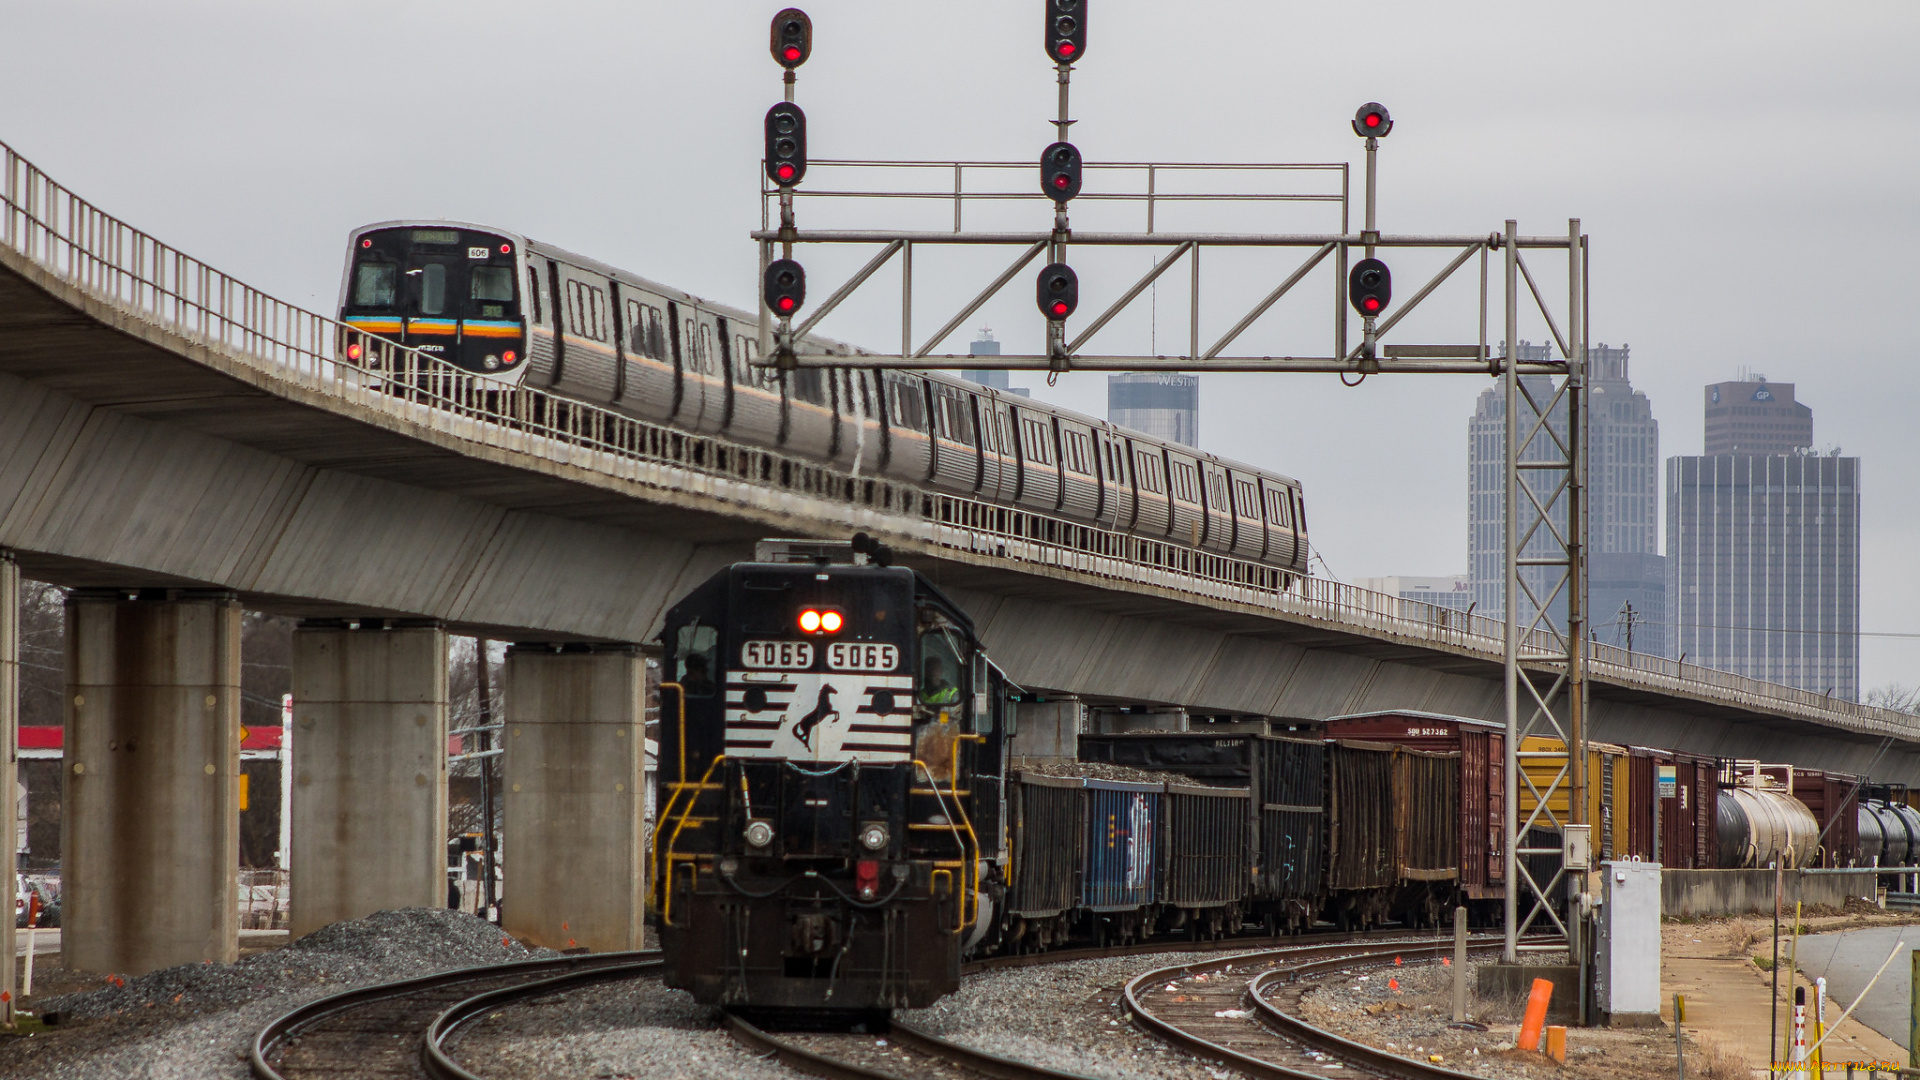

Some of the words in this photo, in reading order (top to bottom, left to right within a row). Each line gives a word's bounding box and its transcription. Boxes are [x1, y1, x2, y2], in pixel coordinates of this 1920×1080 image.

[1157, 375, 1196, 387] WESTIN
[1757, 391, 1769, 400] GP
[748, 643, 808, 666] 5065
[833, 644, 893, 668] 5065
